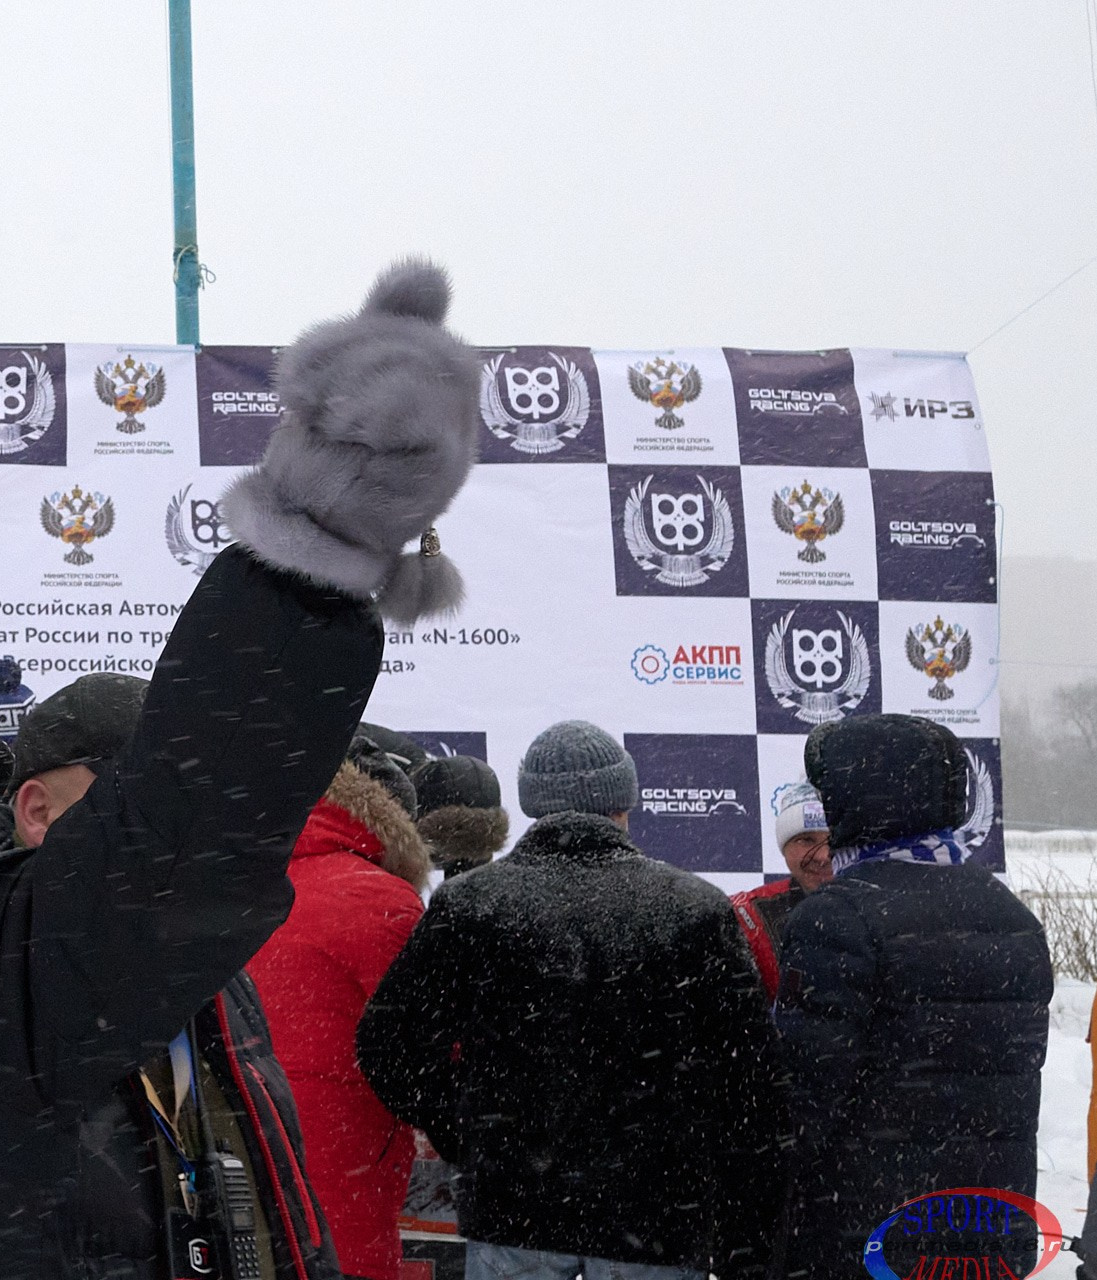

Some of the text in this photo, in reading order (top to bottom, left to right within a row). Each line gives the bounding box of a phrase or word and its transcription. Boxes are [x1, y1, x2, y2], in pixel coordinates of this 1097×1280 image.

[212, 392, 280, 402] GOLTSO
[118, 599, 185, 617] Автом
[25, 627, 100, 644] России
[107, 631, 133, 644] по
[421, 628, 521, 645] «N-1600»
[672, 645, 741, 665] АКПП
[4, 655, 155, 675] сероссийско
[672, 666, 742, 680] СЕРВИС
